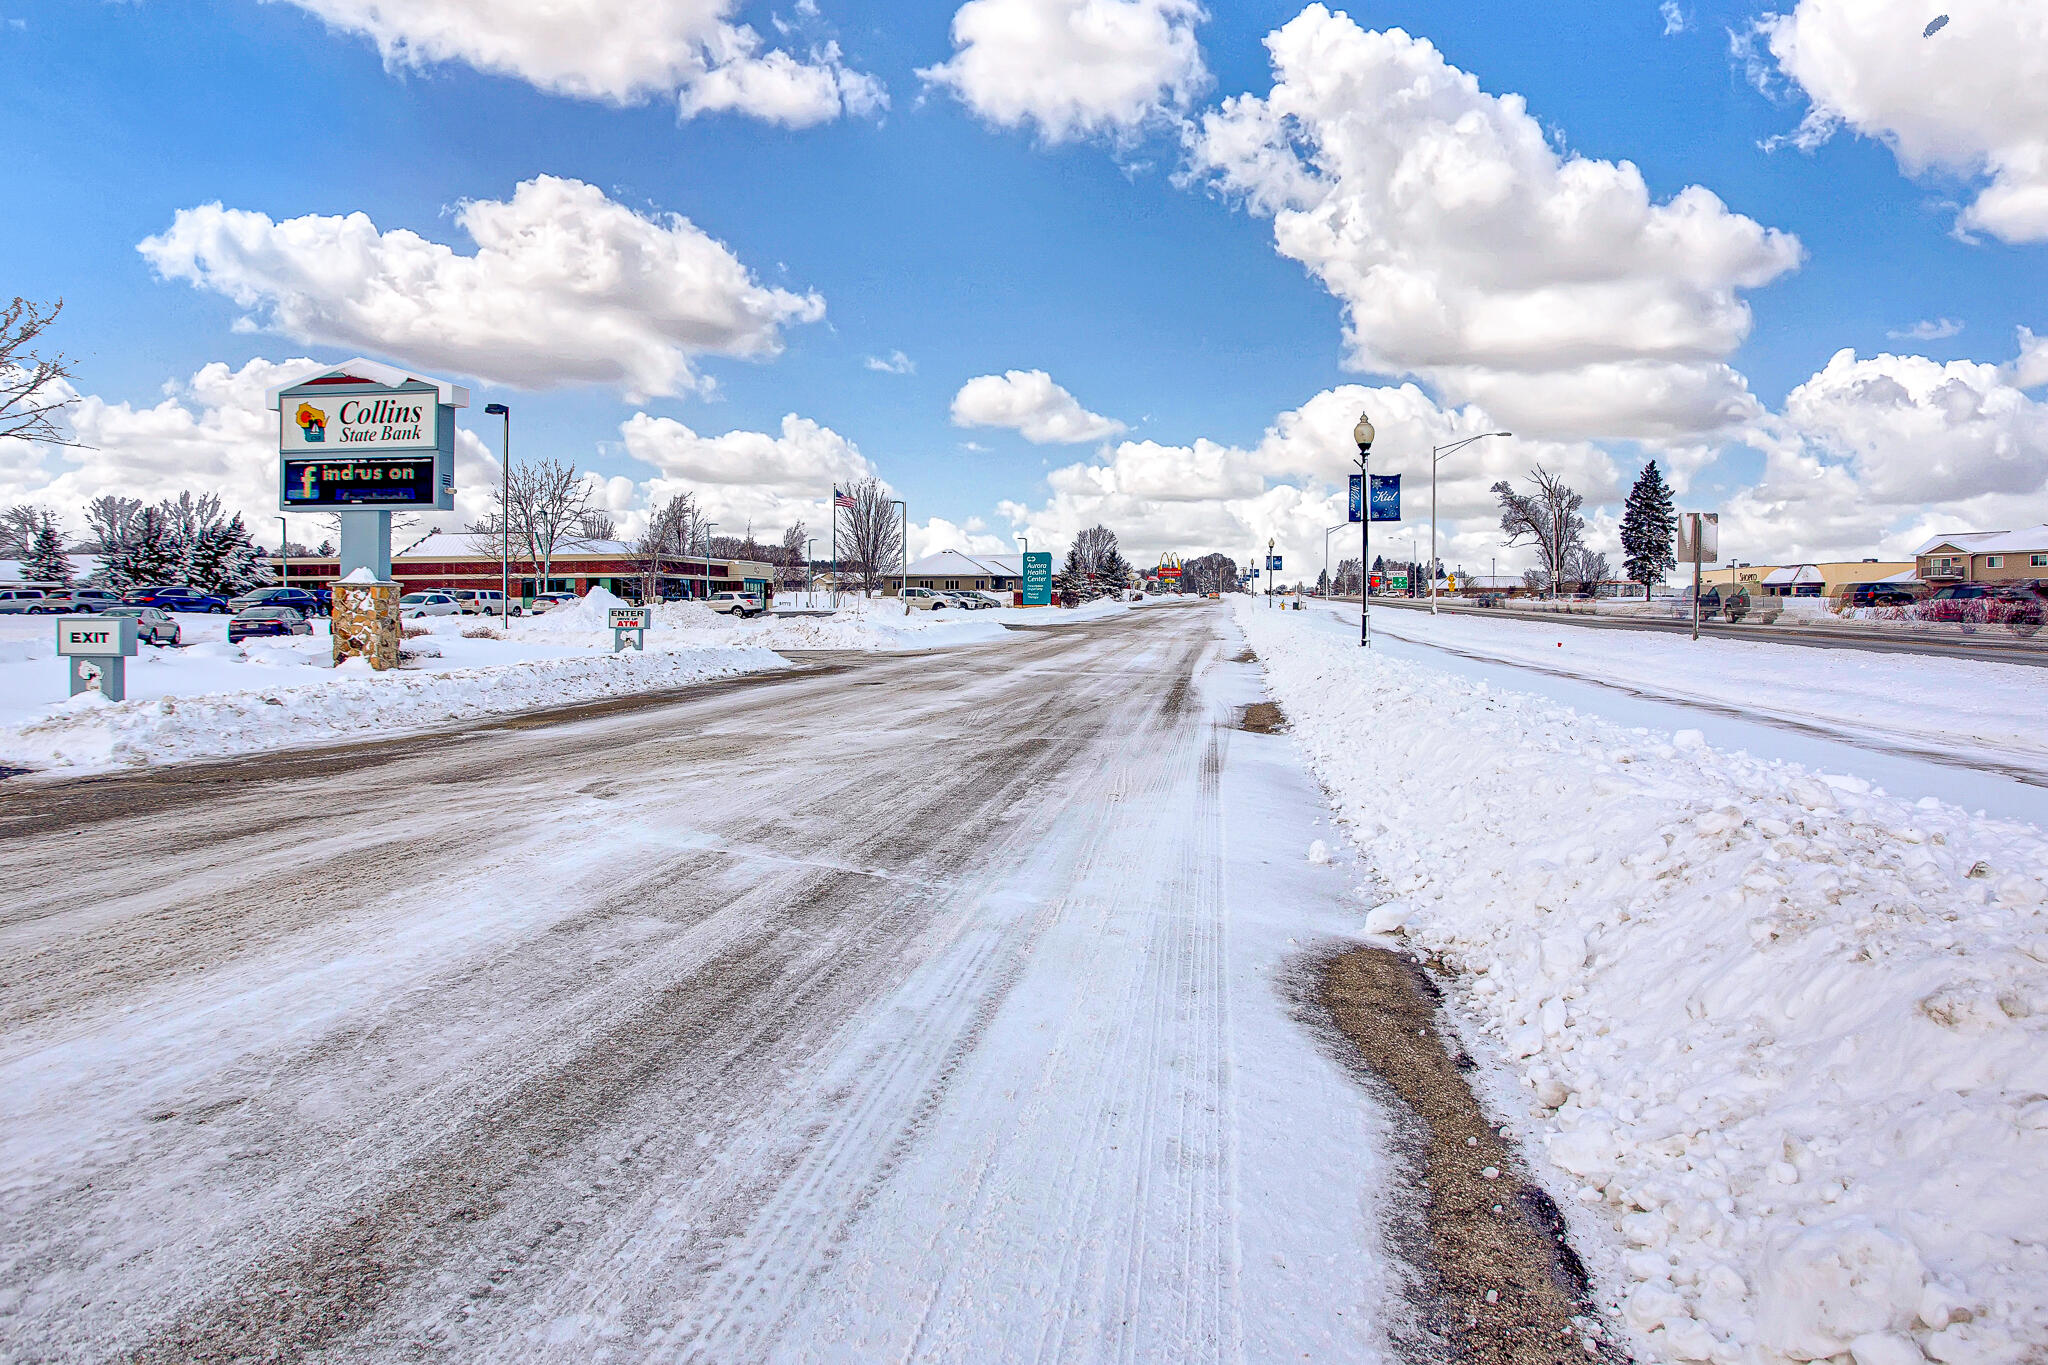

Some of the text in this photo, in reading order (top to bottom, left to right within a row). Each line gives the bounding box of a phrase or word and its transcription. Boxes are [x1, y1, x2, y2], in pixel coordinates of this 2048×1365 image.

[339, 400, 422, 425] Collins
[340, 424, 422, 443] State Bank
[388, 467, 415, 480] on
[1373, 490, 1398, 503] Kiel
[70, 631, 110, 643] EXIT
